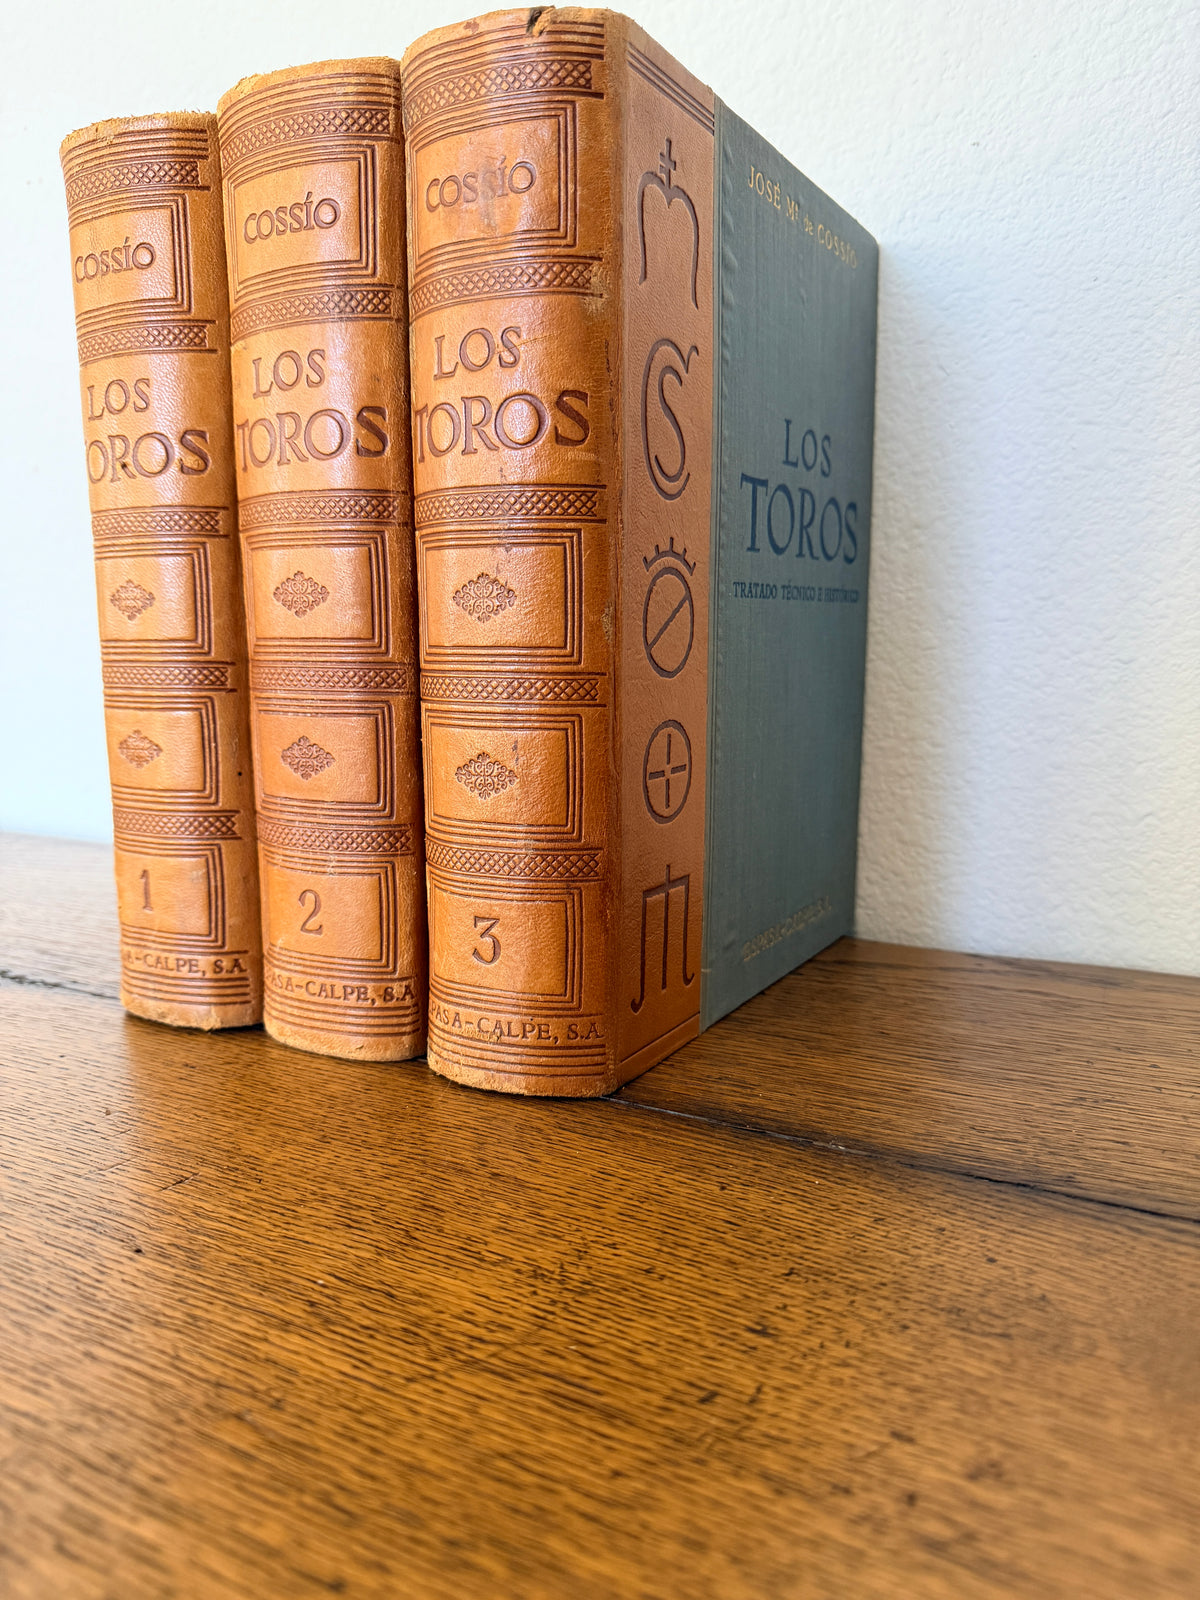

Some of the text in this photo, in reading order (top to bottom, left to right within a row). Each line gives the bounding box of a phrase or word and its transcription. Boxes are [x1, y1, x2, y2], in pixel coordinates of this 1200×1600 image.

[243, 191, 342, 245] COSSÍO
[748, 165, 781, 210] JOSÉ
[803, 213, 815, 236] de
[74, 236, 156, 284] COSSÍO
[252, 349, 326, 400] LOS
[433, 326, 522, 381] LOS
[87, 378, 150, 422] LOS
[415, 389, 591, 464] TOROS
[85, 429, 212, 485] OROS
[236, 405, 390, 473] TOROS
[783, 418, 832, 478] LOS
[740, 472, 859, 565] TOROS
[733, 581, 778, 599] TRATADO
[781, 579, 817, 601] TÉCNICO
[138, 869, 154, 912] 1
[298, 889, 324, 937] 2
[472, 916, 501, 966] 3
